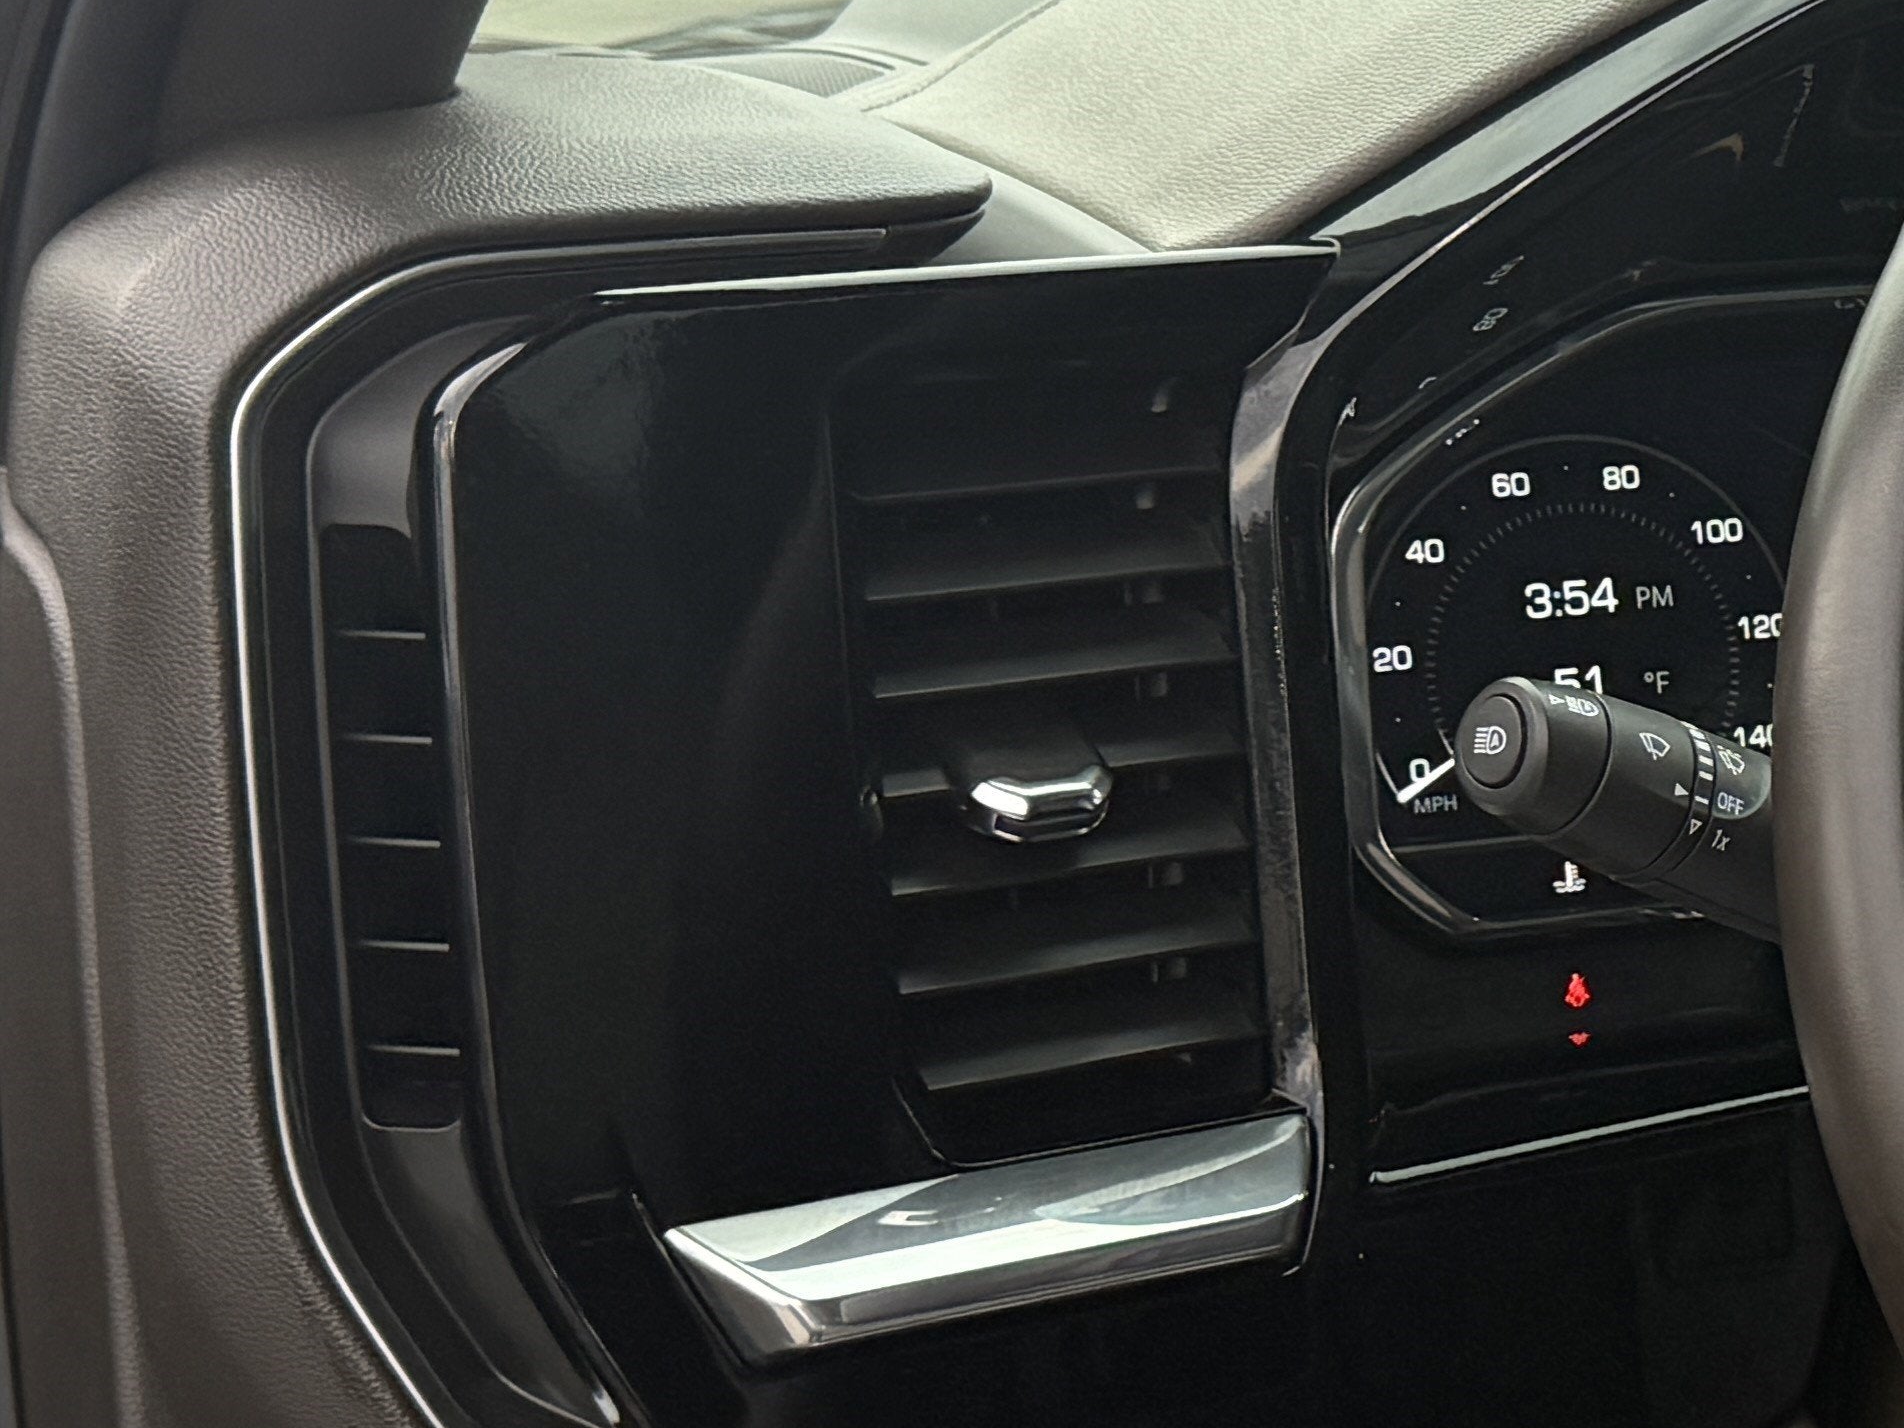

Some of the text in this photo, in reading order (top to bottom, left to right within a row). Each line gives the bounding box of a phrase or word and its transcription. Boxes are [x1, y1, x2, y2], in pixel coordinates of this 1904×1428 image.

[1491, 472, 1531, 498] 60
[1602, 465, 1641, 491] 80
[1691, 517, 1744, 544] 100
[1405, 539, 1445, 565] 40
[1524, 577, 1674, 619] 3:54 PM
[1372, 645, 1413, 672] 20
[1643, 671, 1670, 694] °F
[1409, 758, 1431, 784] 0
[1414, 794, 1458, 814] MPH
[1717, 791, 1745, 815] OFF
[1711, 828, 1731, 851] 1x
